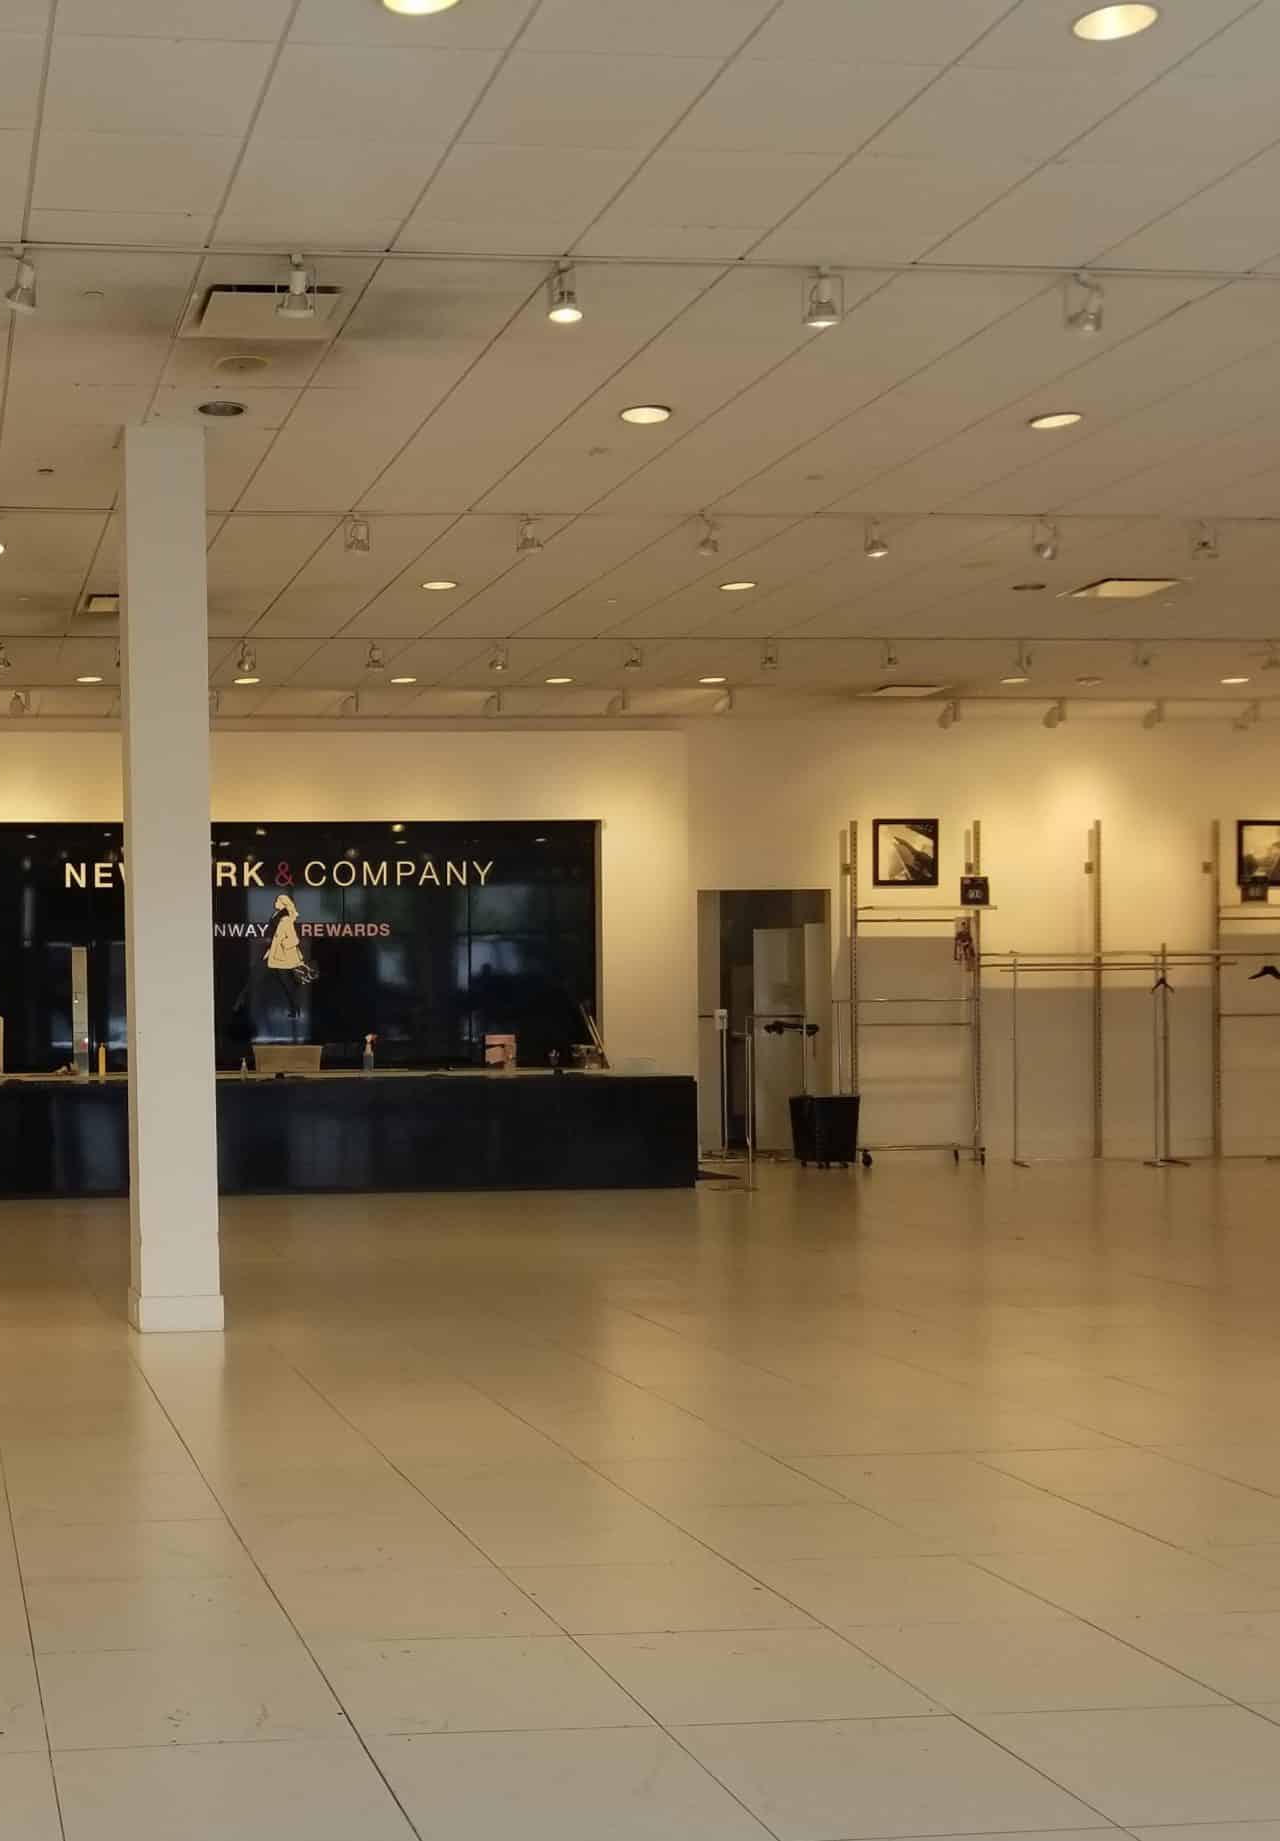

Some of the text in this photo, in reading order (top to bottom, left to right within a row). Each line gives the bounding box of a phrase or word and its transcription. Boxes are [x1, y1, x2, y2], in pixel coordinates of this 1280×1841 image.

[215, 861, 265, 887] RK
[274, 861, 295, 887] &
[304, 860, 495, 887] COMPANY
[213, 923, 391, 937] NWAY REWARDS
